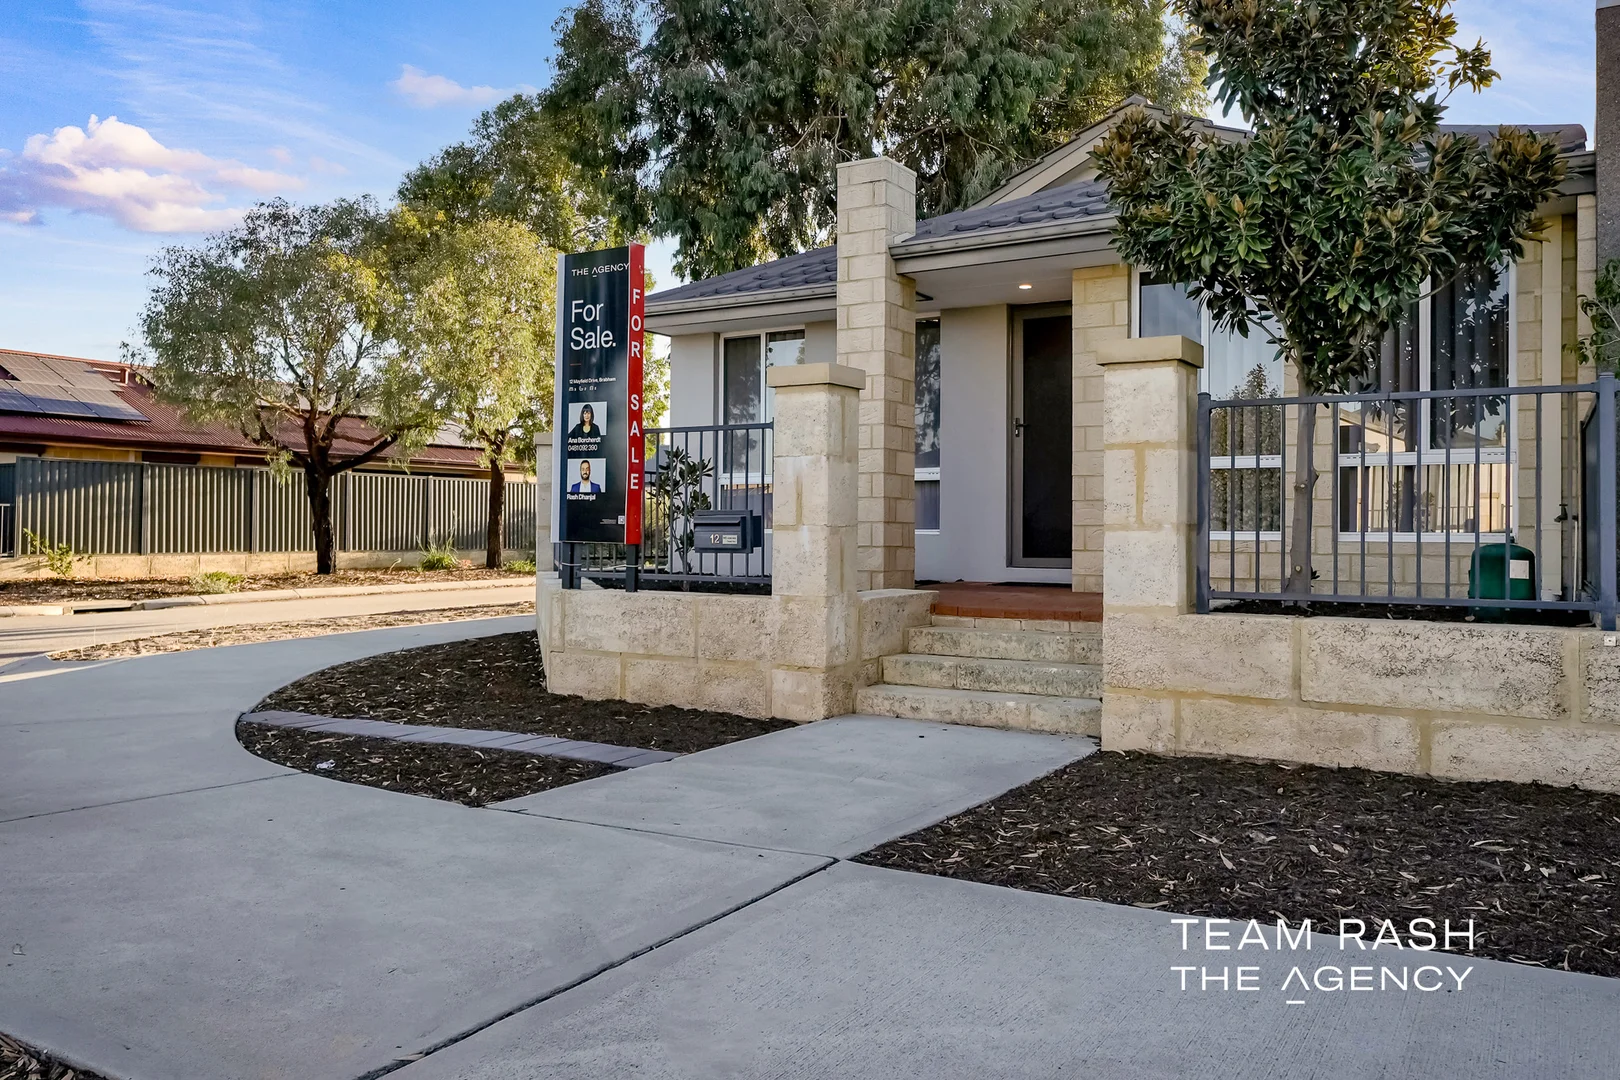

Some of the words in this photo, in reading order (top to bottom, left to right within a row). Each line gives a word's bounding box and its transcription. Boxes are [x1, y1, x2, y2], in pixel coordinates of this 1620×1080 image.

[572, 268, 588, 276] THE
[592, 262, 629, 278] AGENCY
[572, 300, 604, 322] For
[631, 288, 642, 358] FOR
[570, 326, 616, 350] Sale.
[630, 394, 640, 490] SALE
[710, 534, 720, 544] 12
